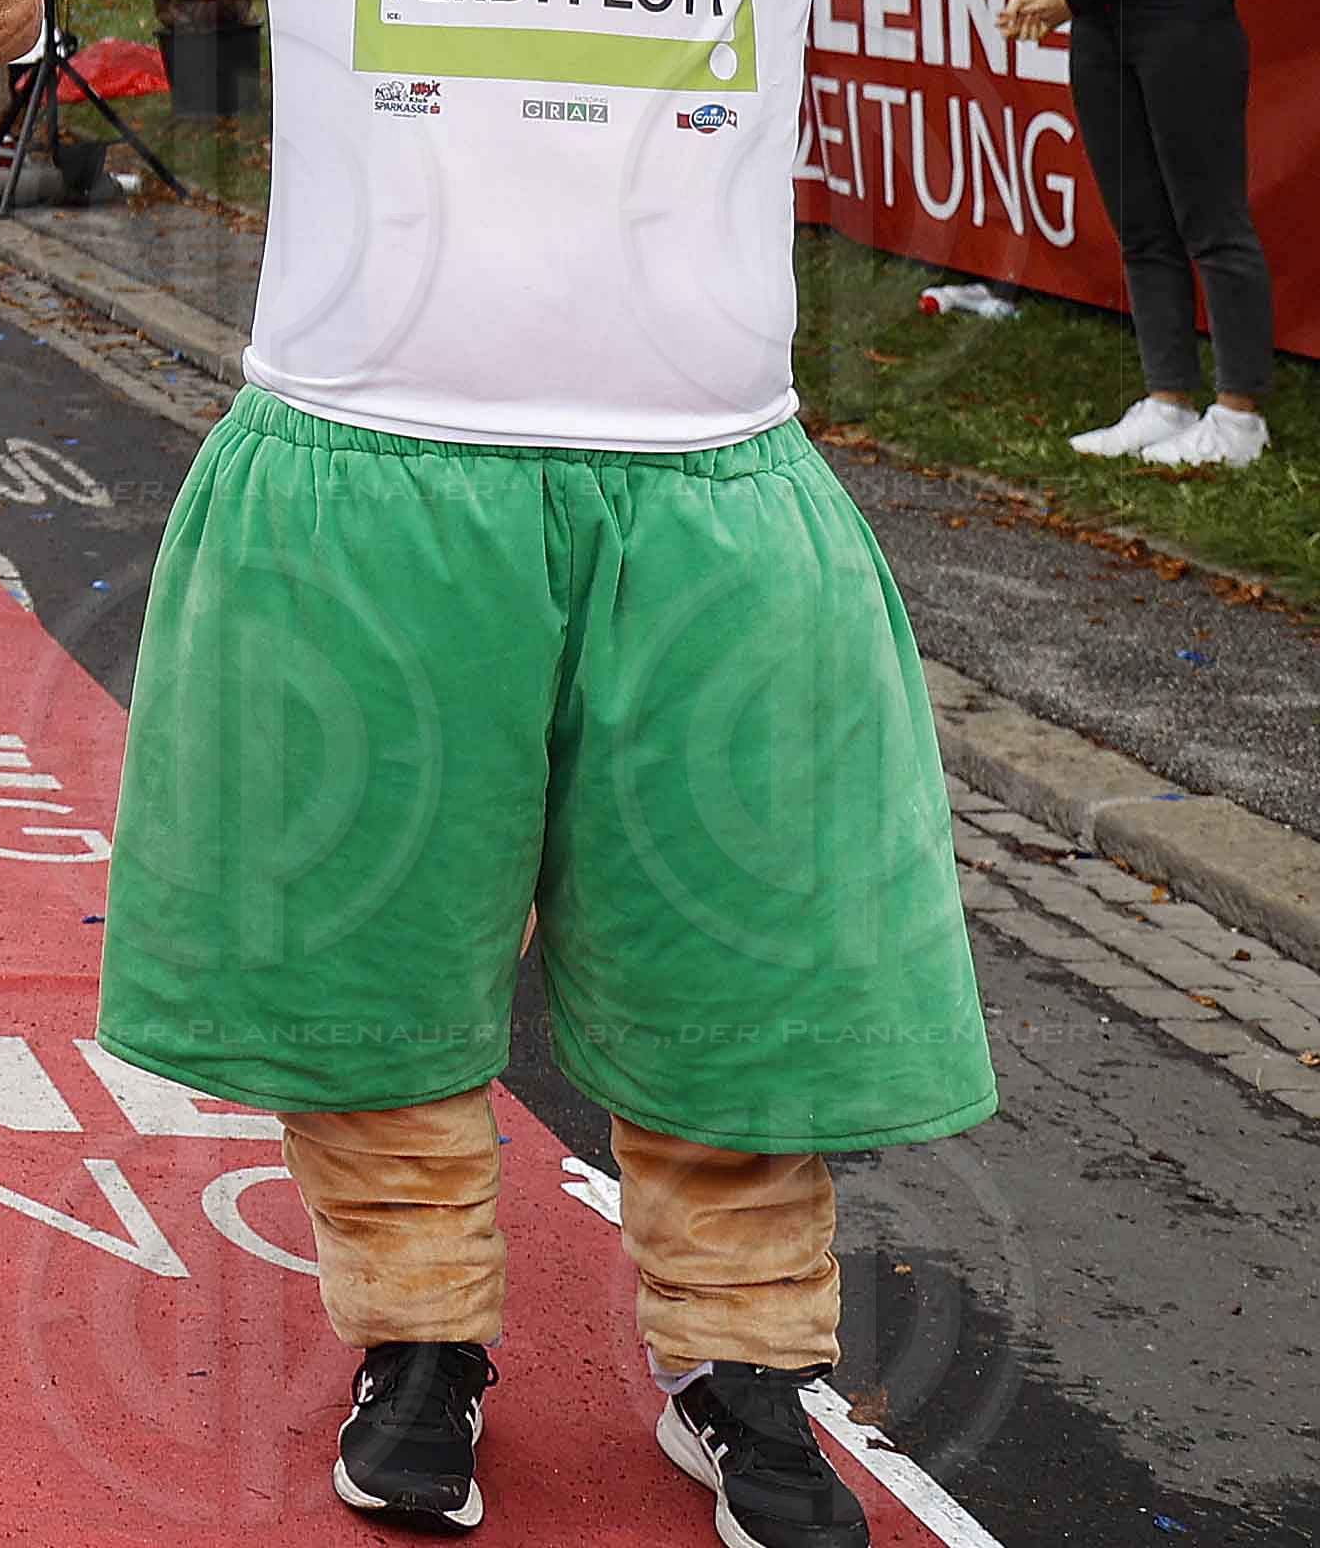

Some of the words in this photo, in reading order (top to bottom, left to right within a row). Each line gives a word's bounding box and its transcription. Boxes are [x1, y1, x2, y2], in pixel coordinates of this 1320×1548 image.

[374, 101, 429, 114] SPARKASSE
[524, 101, 609, 123] GRAZ
[693, 110, 727, 126] Emmi
